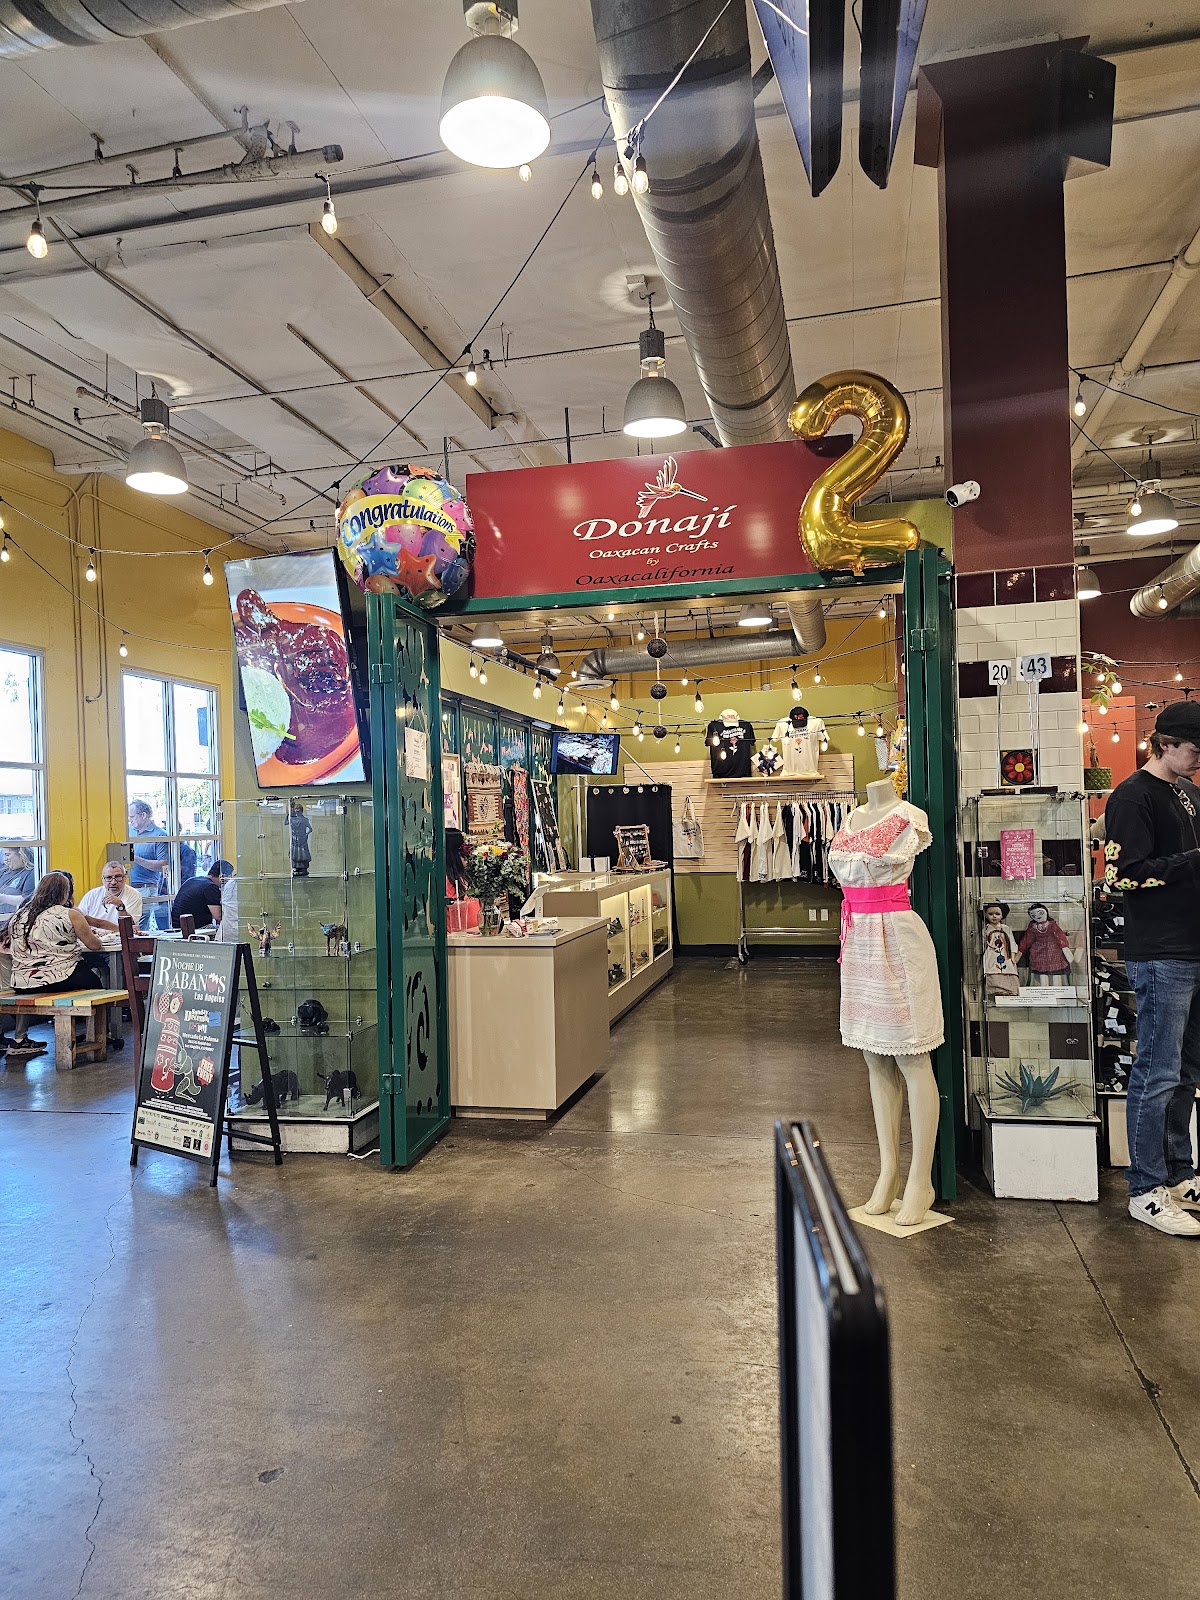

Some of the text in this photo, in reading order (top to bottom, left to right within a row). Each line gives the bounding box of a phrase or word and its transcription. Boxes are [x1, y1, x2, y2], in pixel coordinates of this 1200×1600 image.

[788, 369, 920, 571] 2
[341, 499, 456, 547] Congratulations
[573, 504, 738, 541] Donají
[589, 539, 719, 559] Oaxacan Crafts
[646, 557, 659, 566] by
[575, 564, 735, 586] Oaxacalifornia
[993, 664, 1008, 680] 20
[1027, 657, 1047, 674] 43
[172, 958, 204, 972] NOCHE DE
[194, 992, 225, 1003] Los Angeles
[197, 1066, 213, 1084] EVENT
[201, 1059, 214, 1074] FREE
